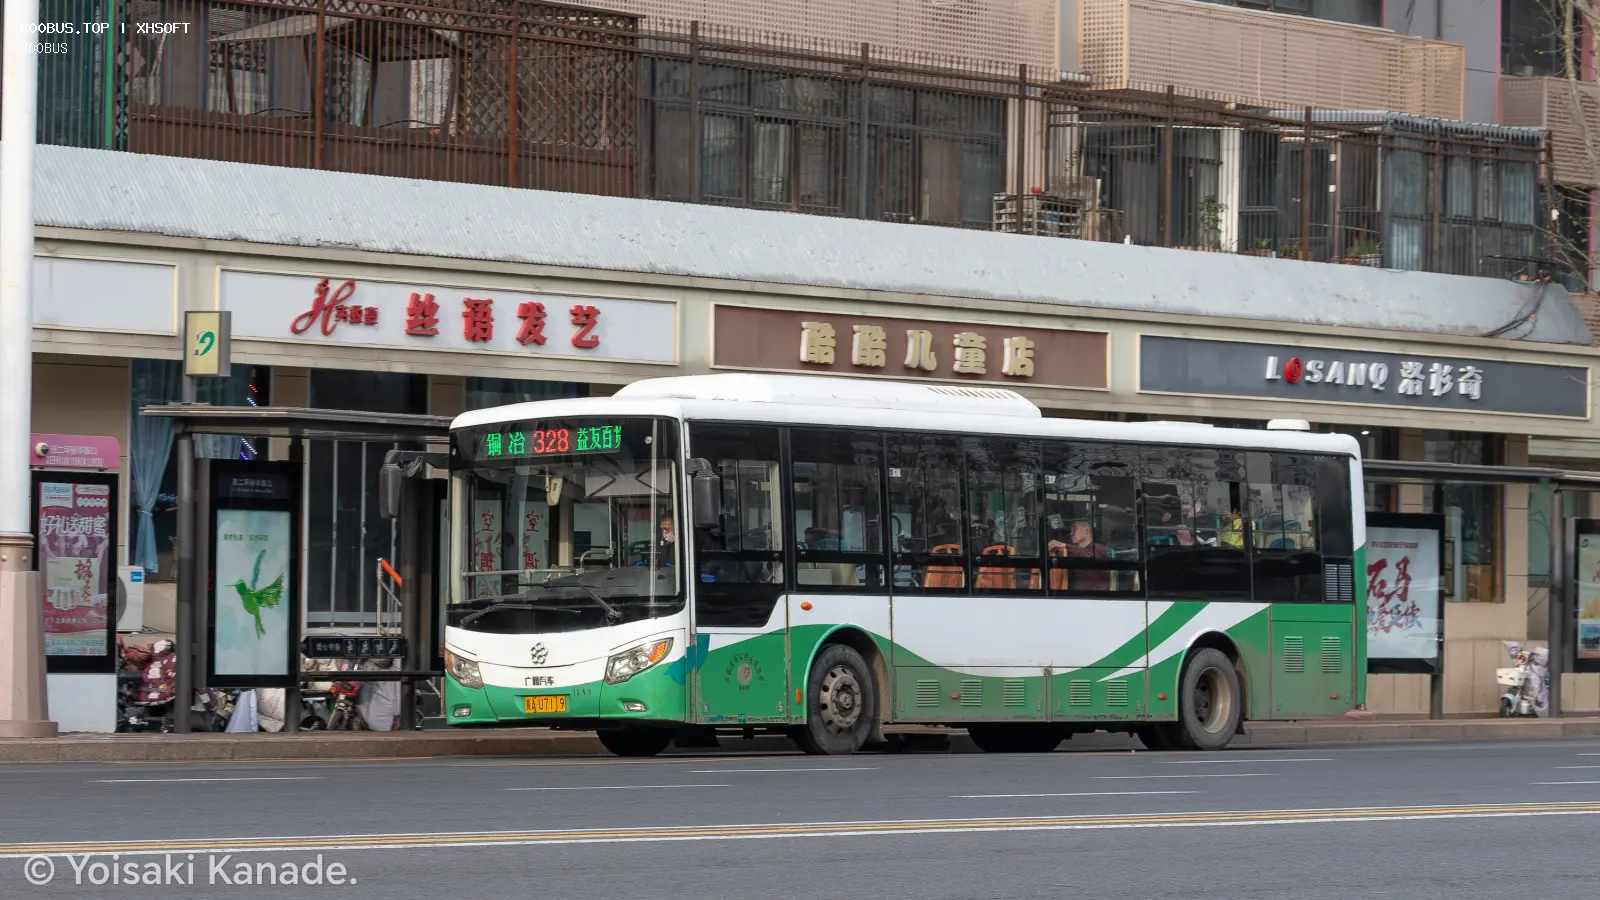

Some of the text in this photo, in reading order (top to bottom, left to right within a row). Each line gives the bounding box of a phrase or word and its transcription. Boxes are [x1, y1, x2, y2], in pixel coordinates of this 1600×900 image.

[405, 292, 601, 349] 丝语发艺
[799, 321, 1036, 378] 酷酷儿童店
[1397, 360, 1484, 400] 洛杉奇
[486, 431, 526, 457] 铜冶
[532, 428, 569, 454] 328
[39, 513, 108, 538] 好礼送甜蜜
